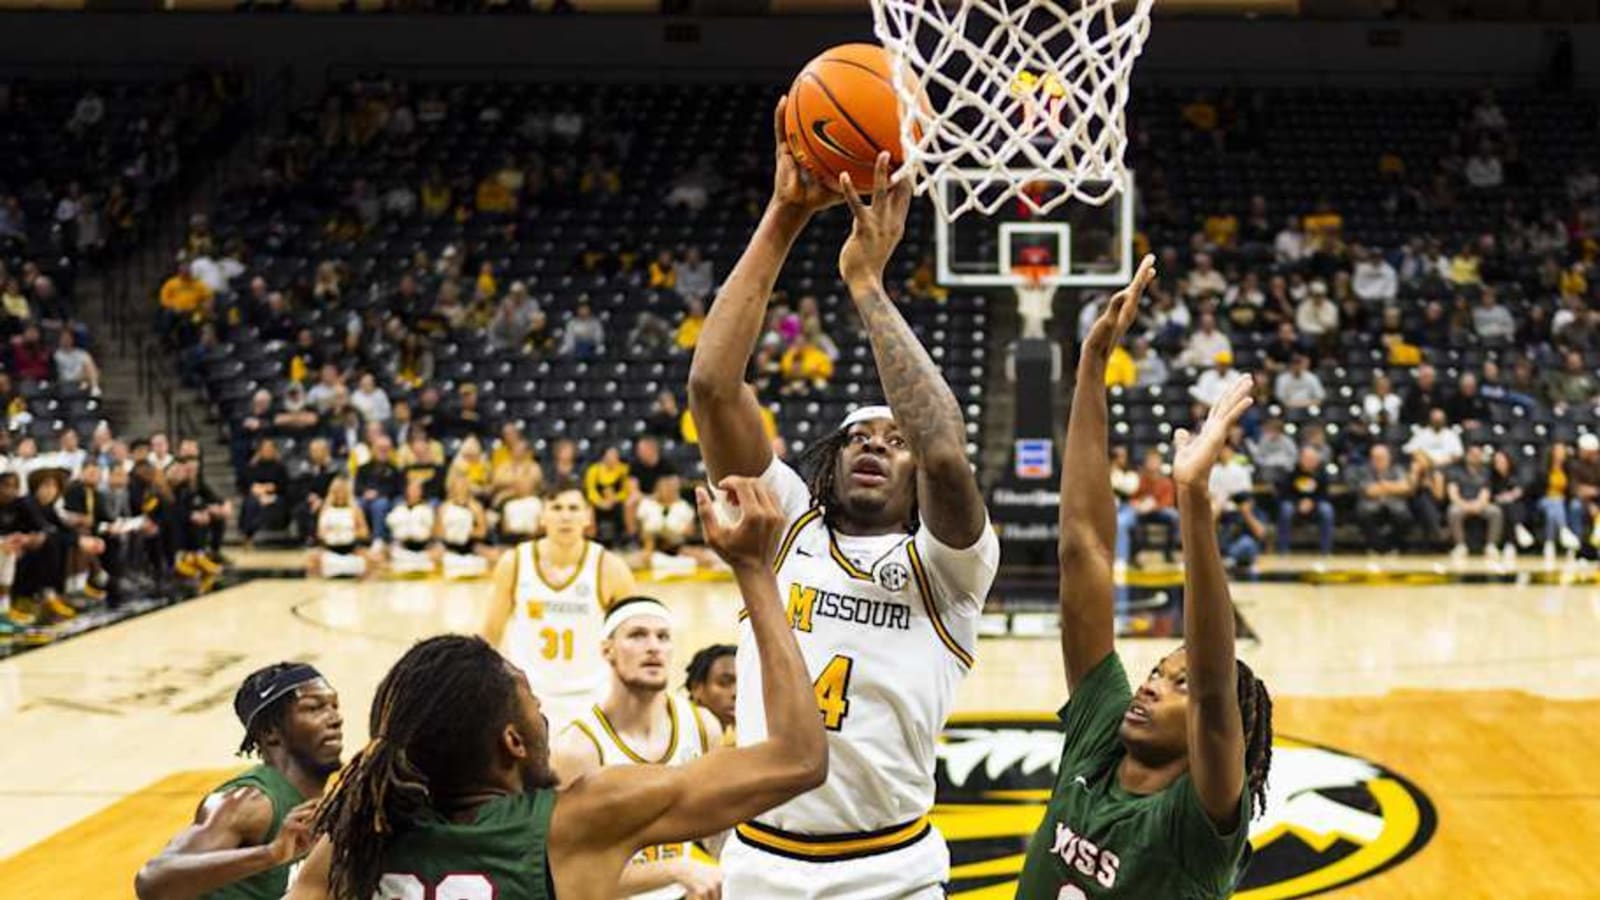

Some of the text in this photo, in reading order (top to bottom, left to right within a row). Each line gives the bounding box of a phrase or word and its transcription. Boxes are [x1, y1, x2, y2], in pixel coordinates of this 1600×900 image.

[787, 583, 910, 633] MISSOURI
[539, 626, 574, 661] 31
[814, 654, 854, 731] 4
